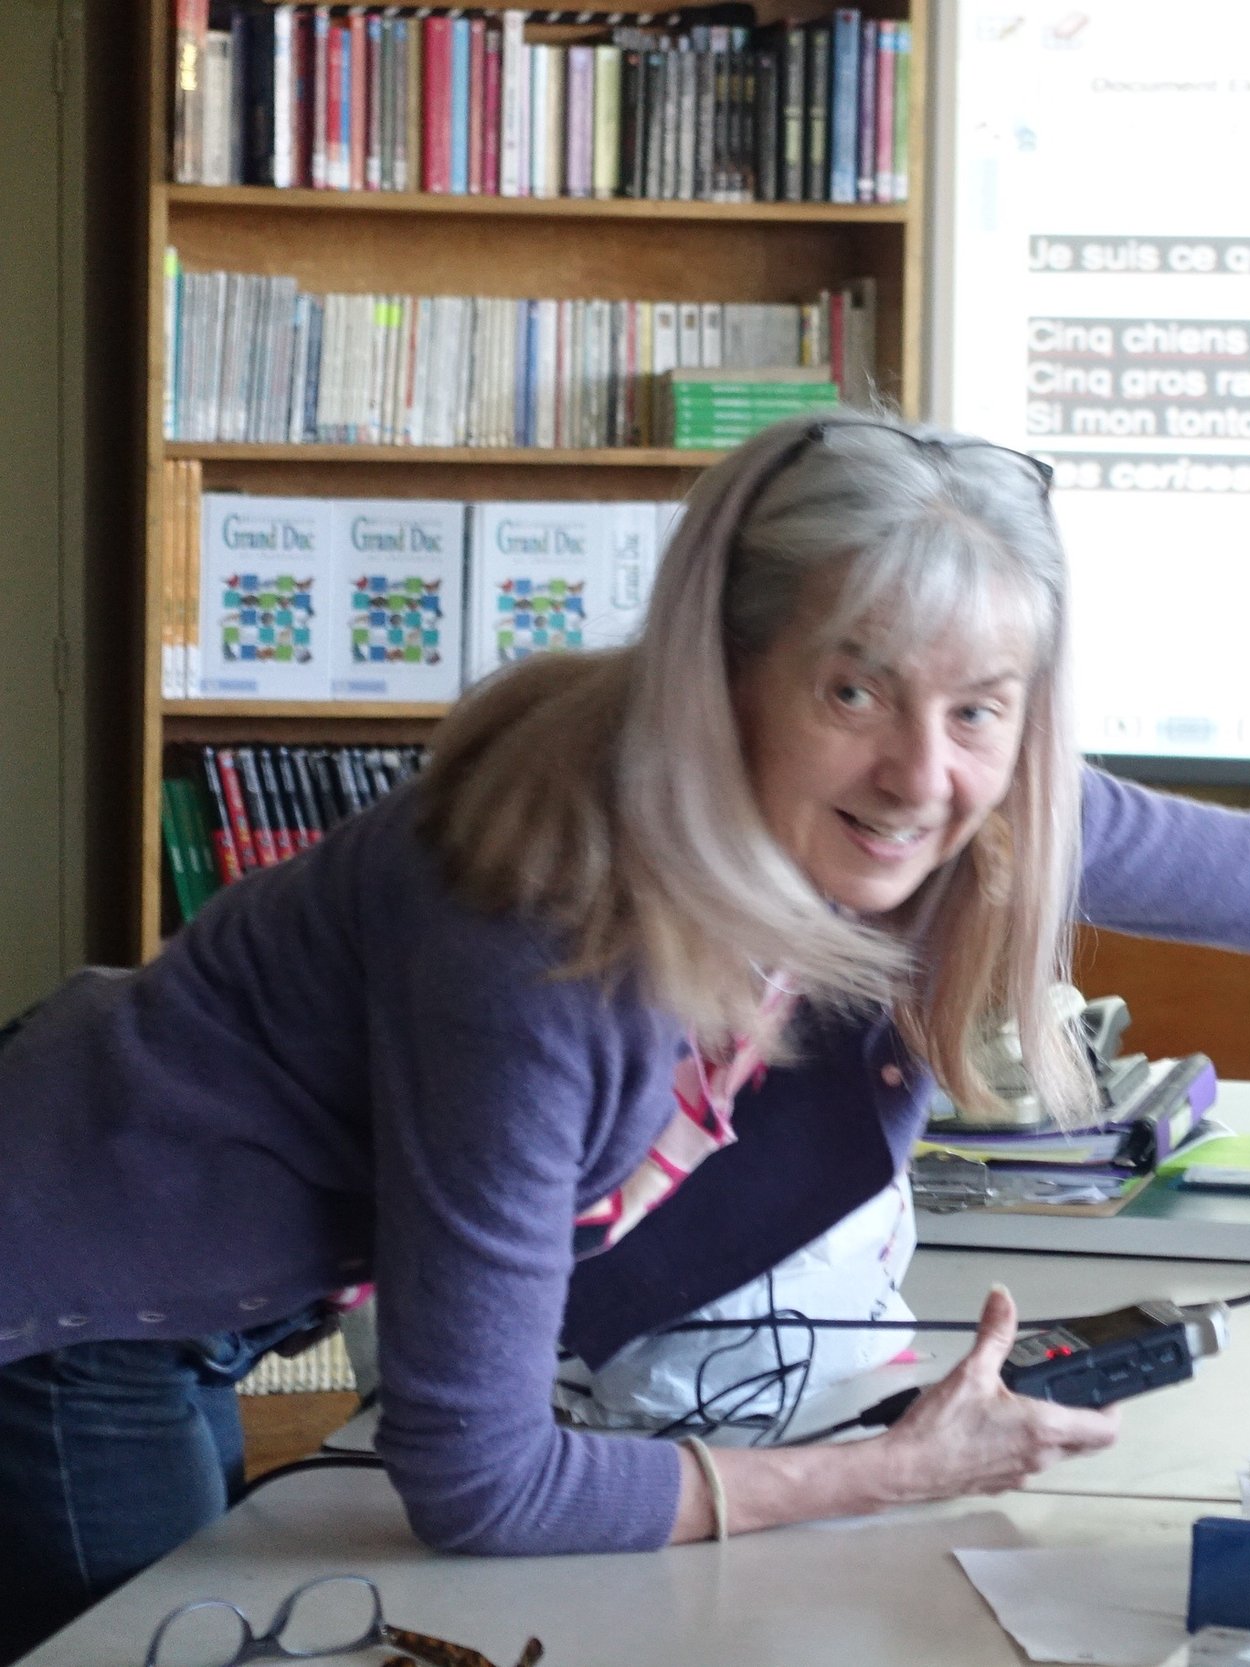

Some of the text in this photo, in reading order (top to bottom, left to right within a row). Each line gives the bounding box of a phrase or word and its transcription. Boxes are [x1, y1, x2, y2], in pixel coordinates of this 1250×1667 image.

[1030, 238, 1074, 271] Je
[1080, 239, 1160, 271] suis
[1168, 244, 1216, 273] ce
[1027, 320, 1113, 355] Cinq
[1122, 324, 1248, 356] chiens
[1027, 362, 1112, 398] Cinq
[1121, 370, 1207, 401] gros
[1027, 402, 1062, 434] Si
[1072, 408, 1157, 436] mon
[222, 513, 276, 551] Grand
[351, 514, 404, 553] Grand
